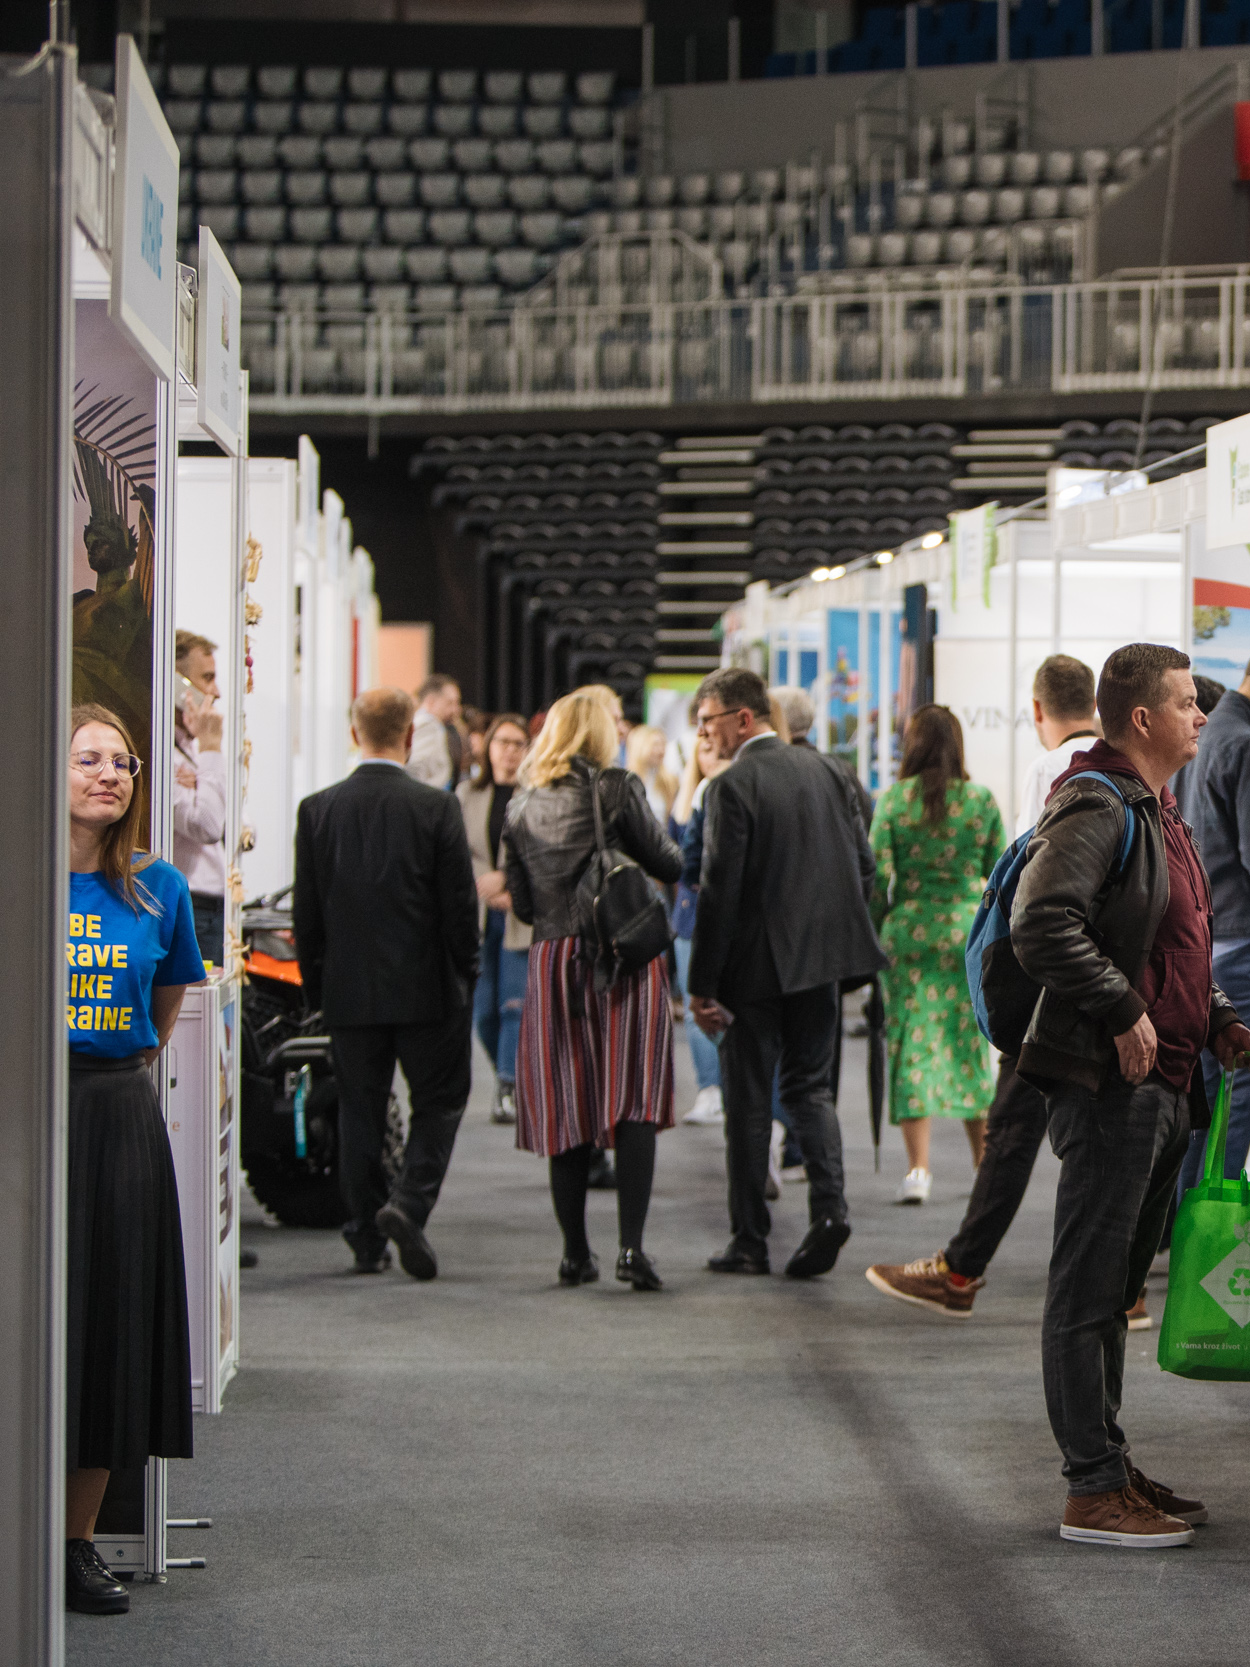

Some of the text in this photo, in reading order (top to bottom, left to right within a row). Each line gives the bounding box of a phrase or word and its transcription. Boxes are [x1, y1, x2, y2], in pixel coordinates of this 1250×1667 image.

[69, 913, 101, 938] BE
[66, 943, 128, 968] RaVE
[65, 974, 113, 999] IKE
[66, 1005, 133, 1031] RaINE
[1203, 1342, 1220, 1350] kroz
[1221, 1342, 1241, 1350] život
